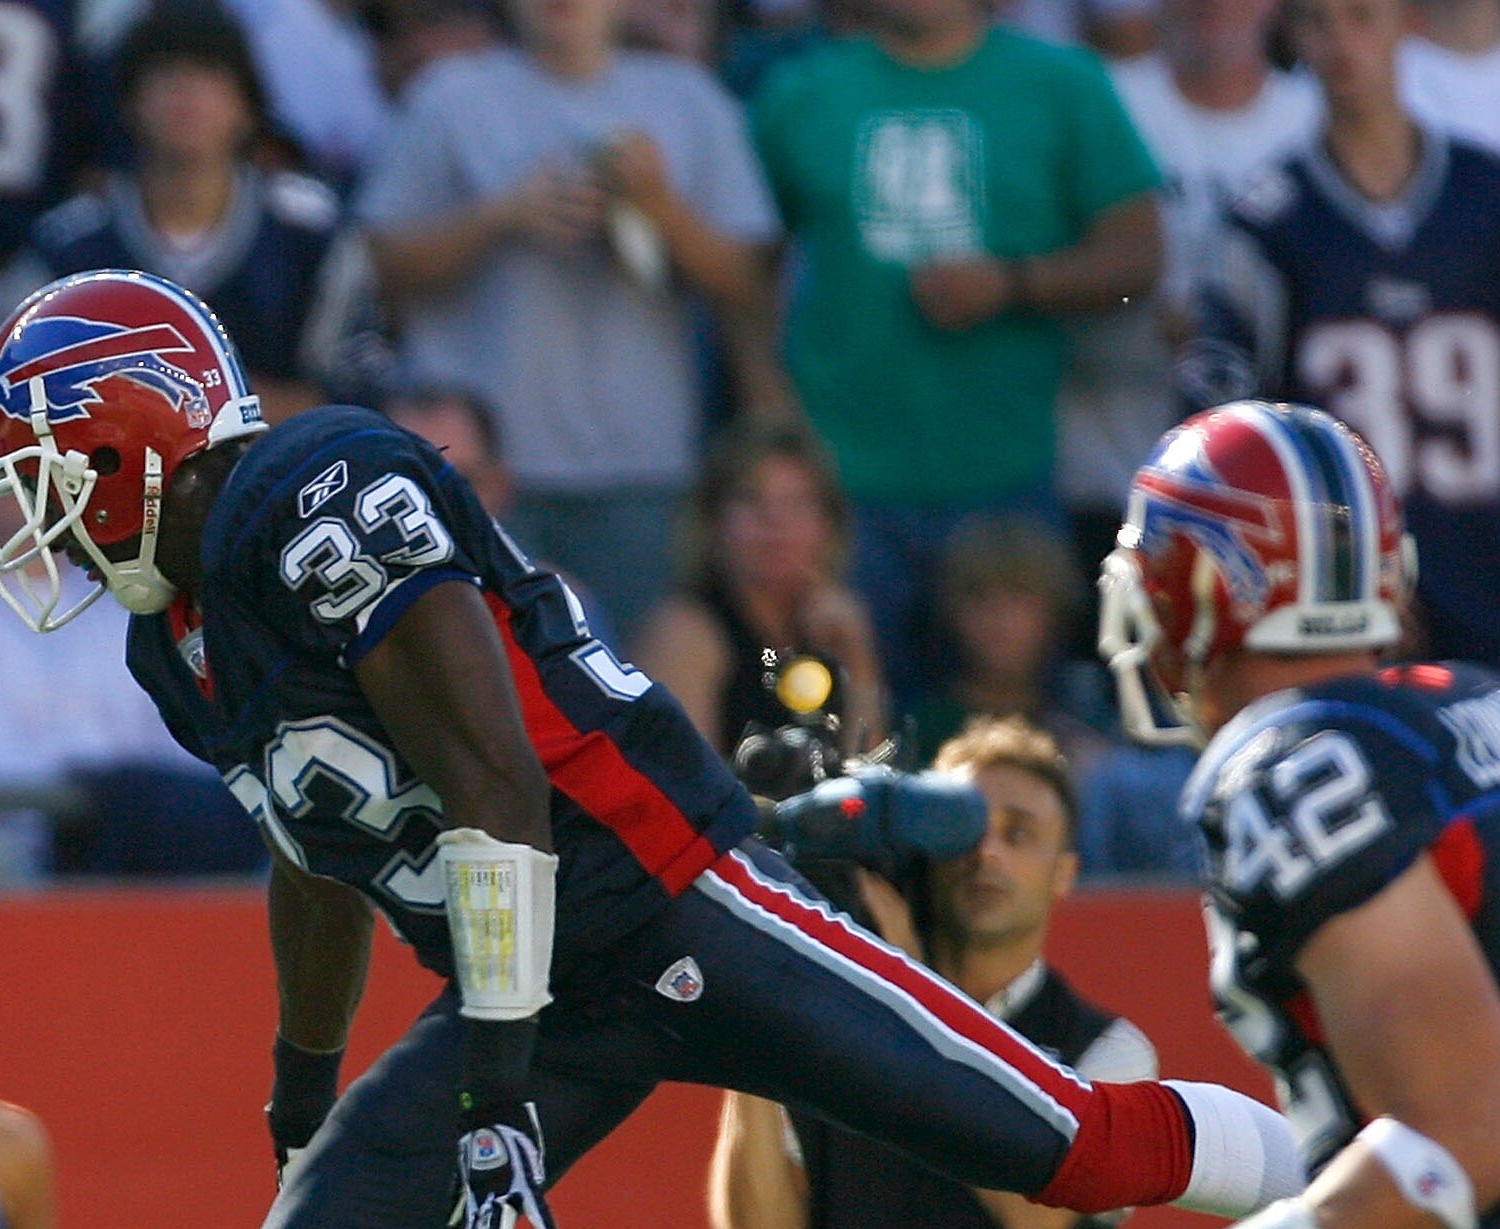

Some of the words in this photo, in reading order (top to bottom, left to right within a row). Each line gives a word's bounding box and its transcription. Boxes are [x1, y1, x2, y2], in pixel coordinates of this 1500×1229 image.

[203, 368, 222, 388] 33
[279, 472, 455, 624] 33
[1222, 727, 1390, 900] 42
